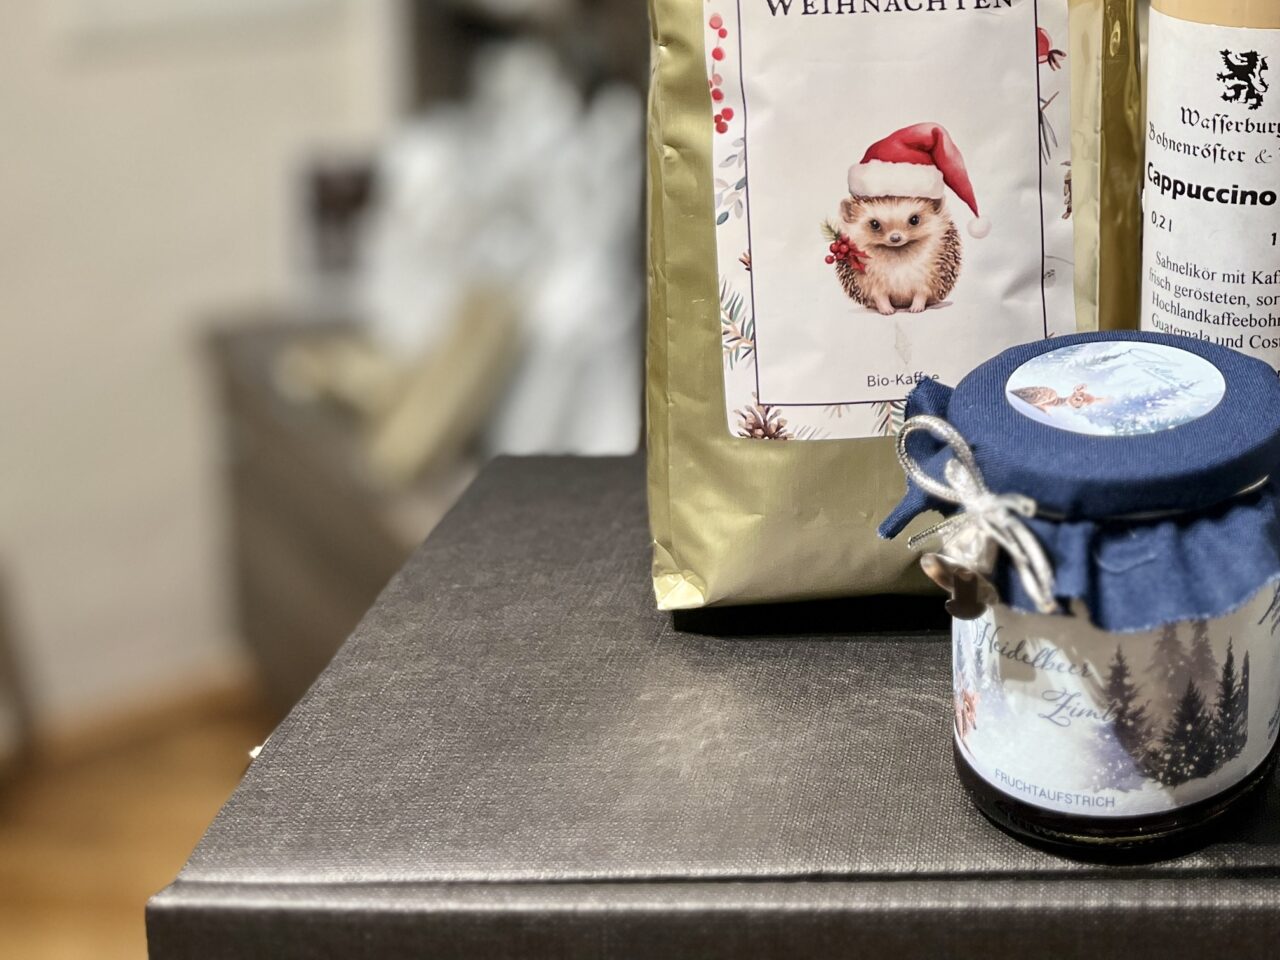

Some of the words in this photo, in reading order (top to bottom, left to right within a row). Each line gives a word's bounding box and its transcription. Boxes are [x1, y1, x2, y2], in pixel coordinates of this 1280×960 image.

[1255, 149, 1272, 164] &
[1147, 162, 1277, 206] Cappuccino
[1149, 267, 1171, 292] frisch
[1174, 284, 1250, 308] gerösteten,
[1155, 251, 1217, 281] Sahnelikör
[1222, 269, 1246, 285] mit
[1152, 312, 1211, 342] Guatemala
[1216, 334, 1244, 349] und
[866, 370, 941, 388] Bio-Kaffe
[973, 618, 1094, 679] Heidelbeer
[1037, 687, 1123, 728] Zimt
[994, 767, 1116, 808] FRUCHTAUFSTRICH
